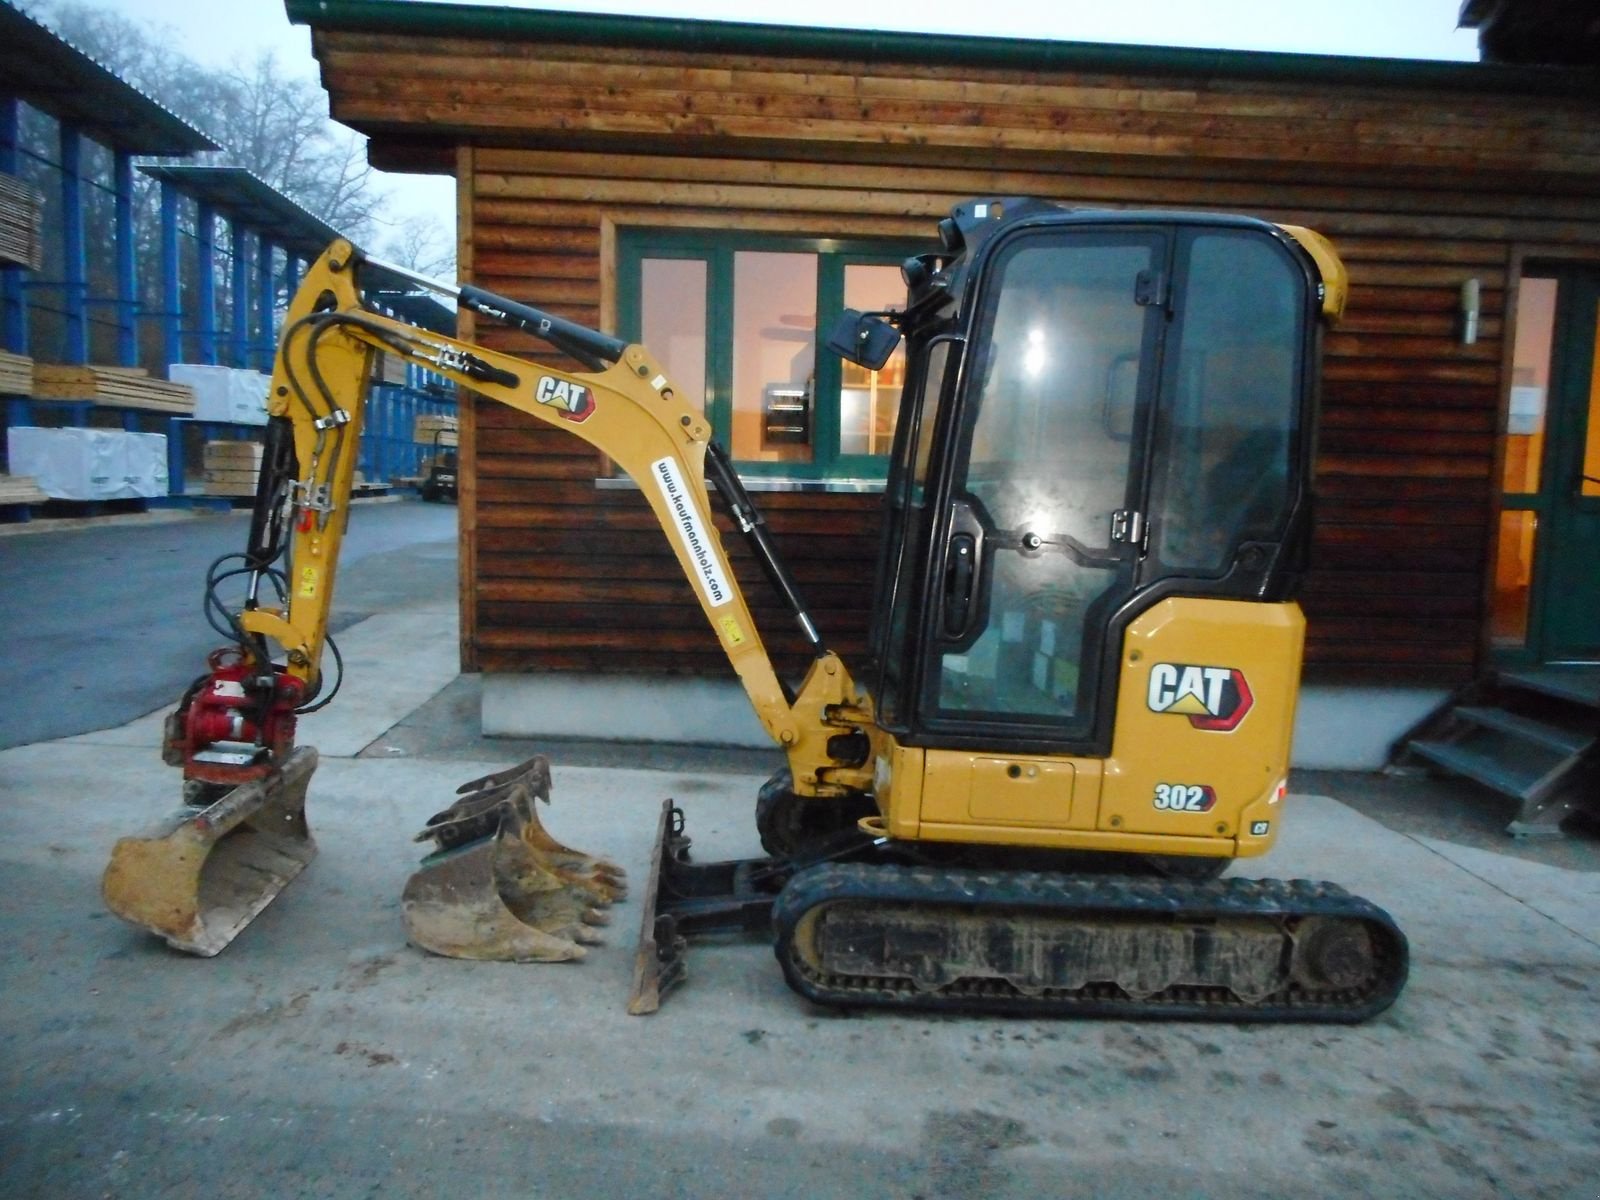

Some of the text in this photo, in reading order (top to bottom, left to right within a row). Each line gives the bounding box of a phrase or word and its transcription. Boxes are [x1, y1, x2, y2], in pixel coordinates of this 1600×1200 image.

[536, 376, 585, 412] CAT
[658, 462, 723, 601] www.kaufmannholz.com
[1148, 663, 1231, 716] CAT
[1154, 784, 1203, 811] 302
